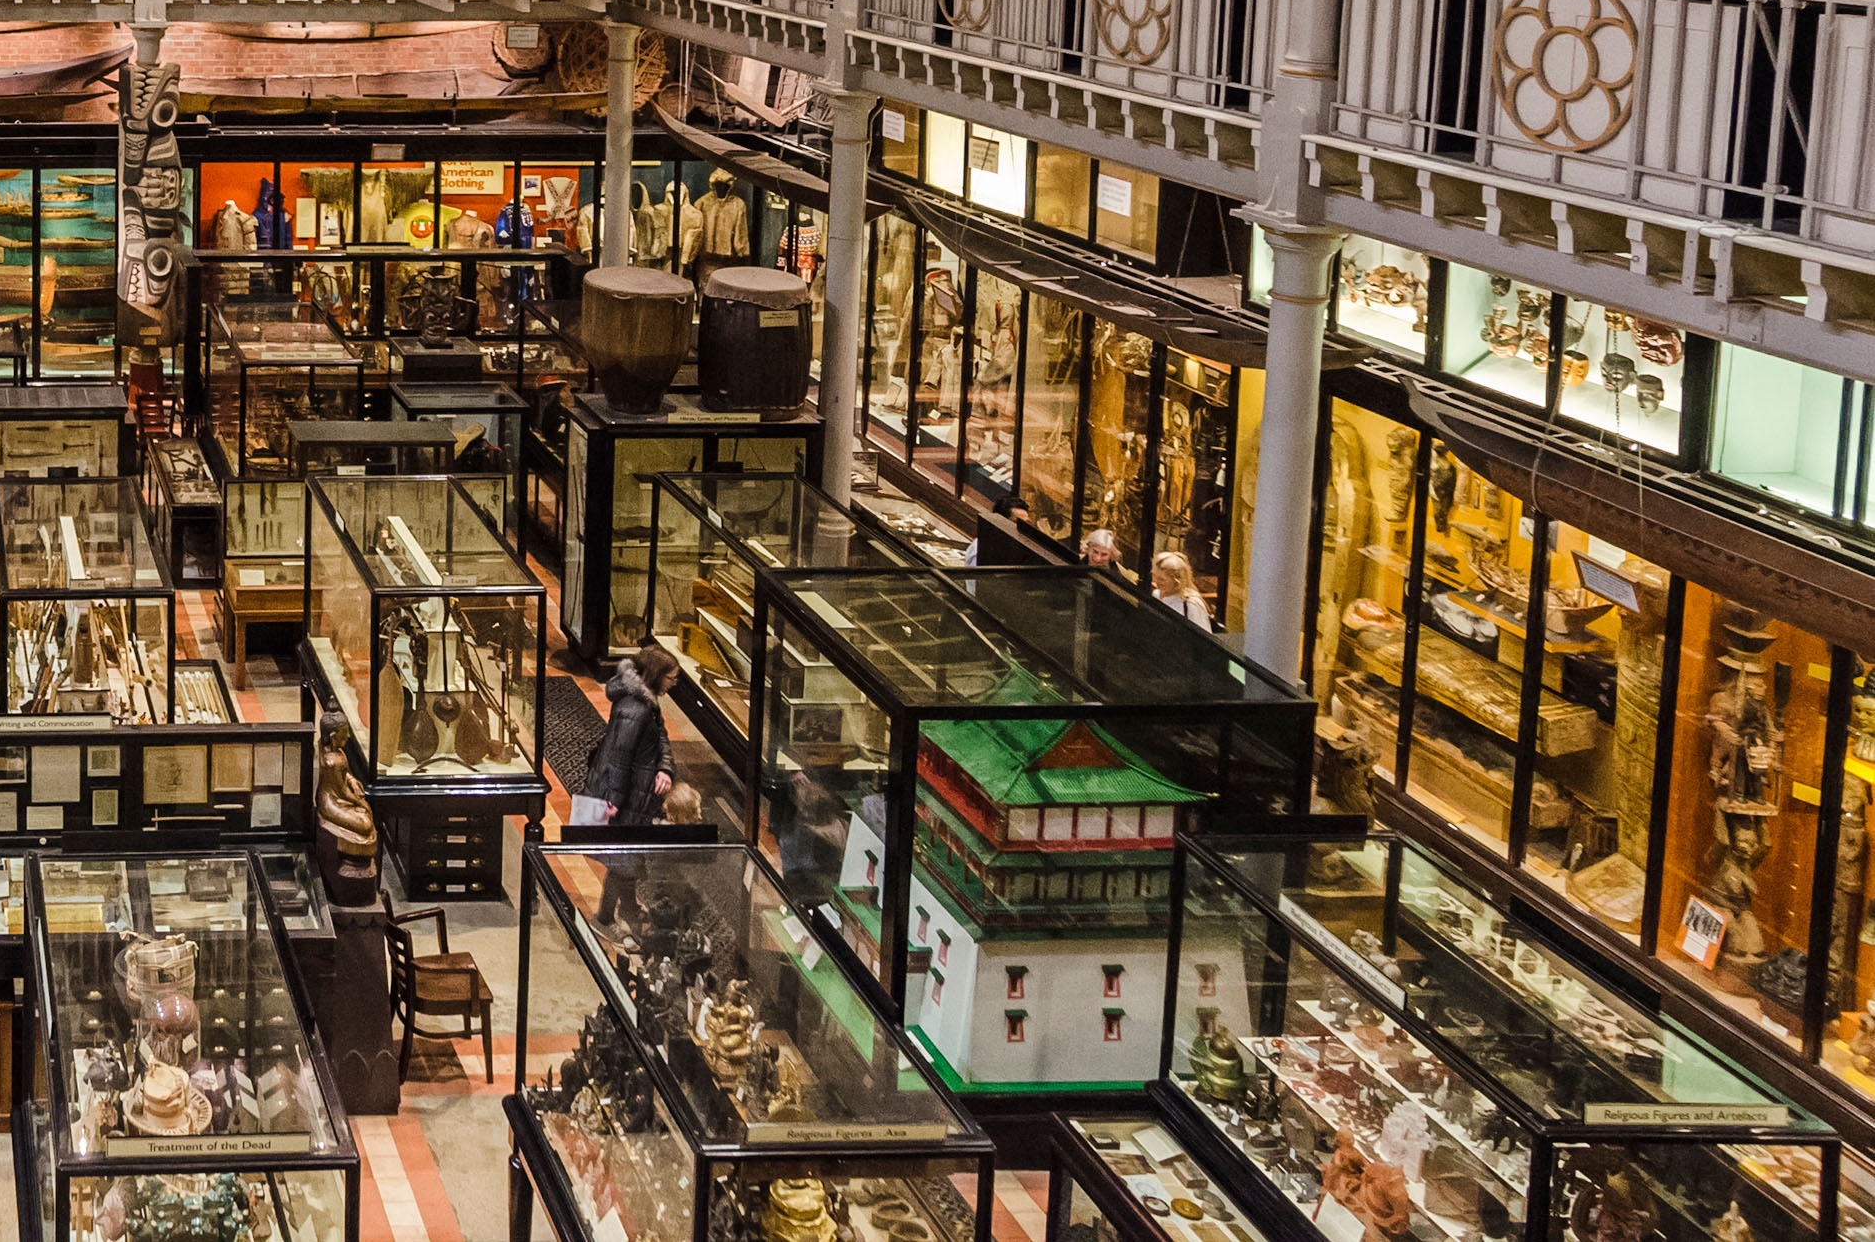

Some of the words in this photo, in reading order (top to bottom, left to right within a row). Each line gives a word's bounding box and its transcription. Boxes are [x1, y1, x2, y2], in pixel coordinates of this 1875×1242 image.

[38, 719, 94, 727] Communication
[1604, 1109, 1649, 1122] Religious
[1653, 1110, 1690, 1123] Figures
[1694, 1110, 1713, 1120] and
[1718, 1110, 1768, 1121] Artefacts
[786, 1129, 831, 1140] Religious
[836, 1128, 873, 1140] Figures
[148, 1142, 203, 1153] Treatment
[207, 1141, 218, 1151] of
[221, 1141, 238, 1151] the
[242, 1140, 271, 1150] Dead
